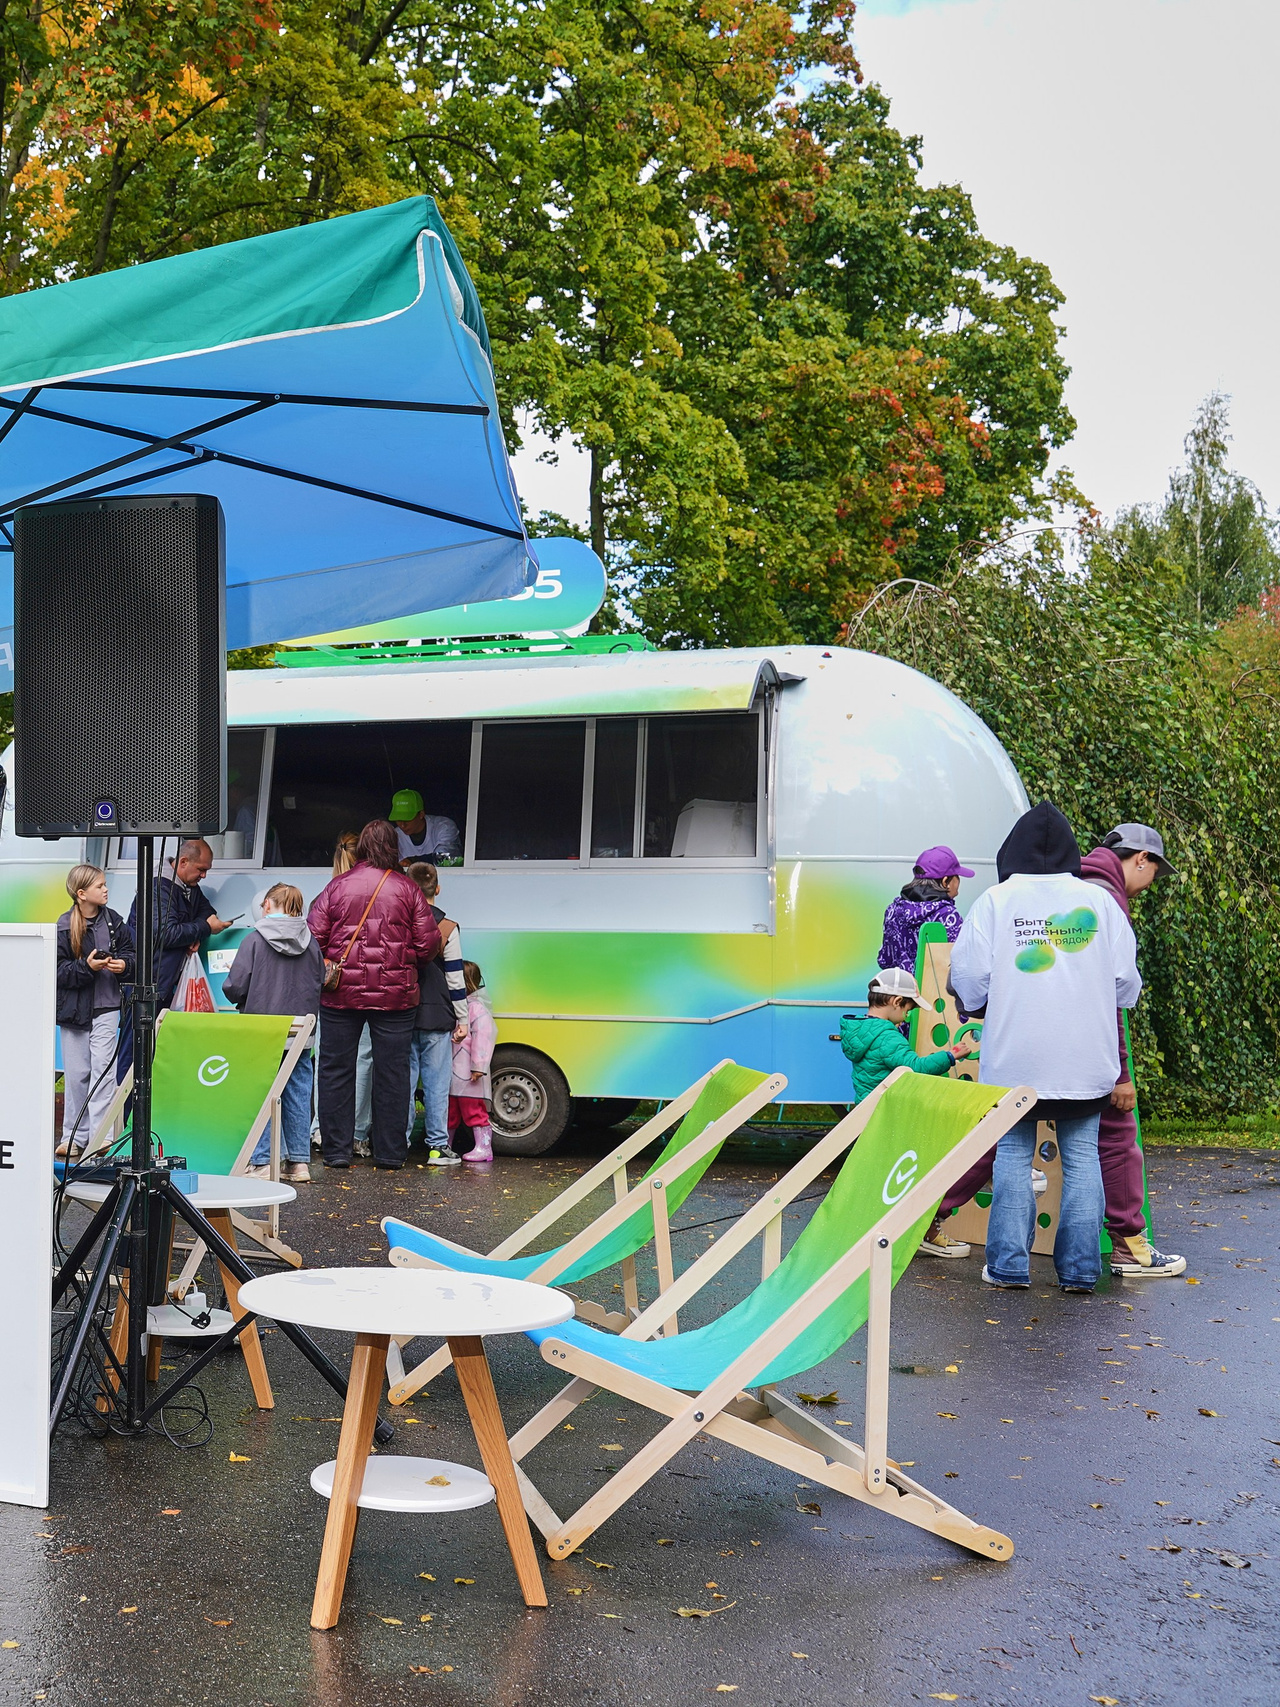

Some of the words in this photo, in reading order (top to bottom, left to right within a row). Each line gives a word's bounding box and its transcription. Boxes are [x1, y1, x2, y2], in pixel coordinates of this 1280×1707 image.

[1014, 918, 1053, 927] Быть
[1014, 926, 1083, 937] зелёным
[1015, 938, 1052, 947] значит
[1055, 937, 1089, 947] рядом
